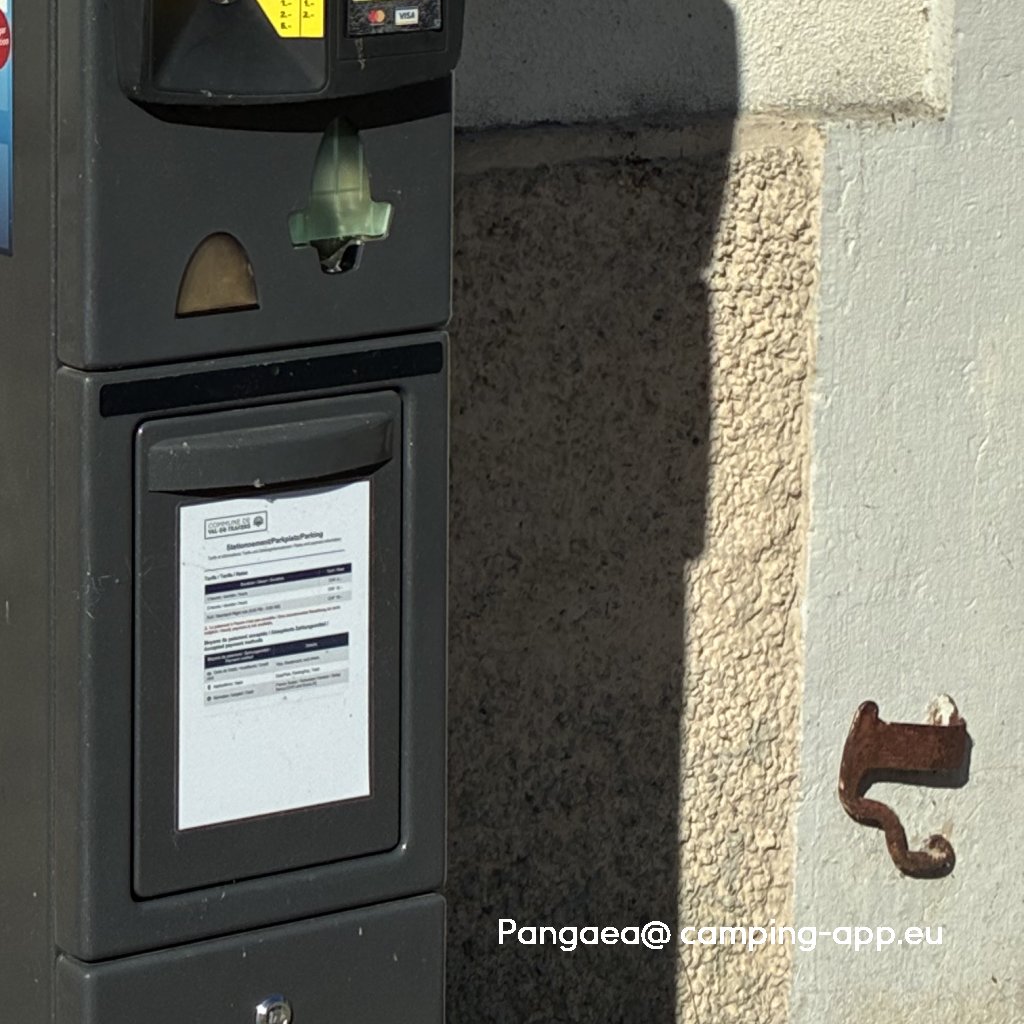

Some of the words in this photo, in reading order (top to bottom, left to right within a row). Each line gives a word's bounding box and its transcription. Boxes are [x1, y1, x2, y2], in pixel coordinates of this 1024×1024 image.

[280, 0, 292, 7] 1.-
[303, 0, 315, 7] 1.-
[399, 11, 416, 20] VISA
